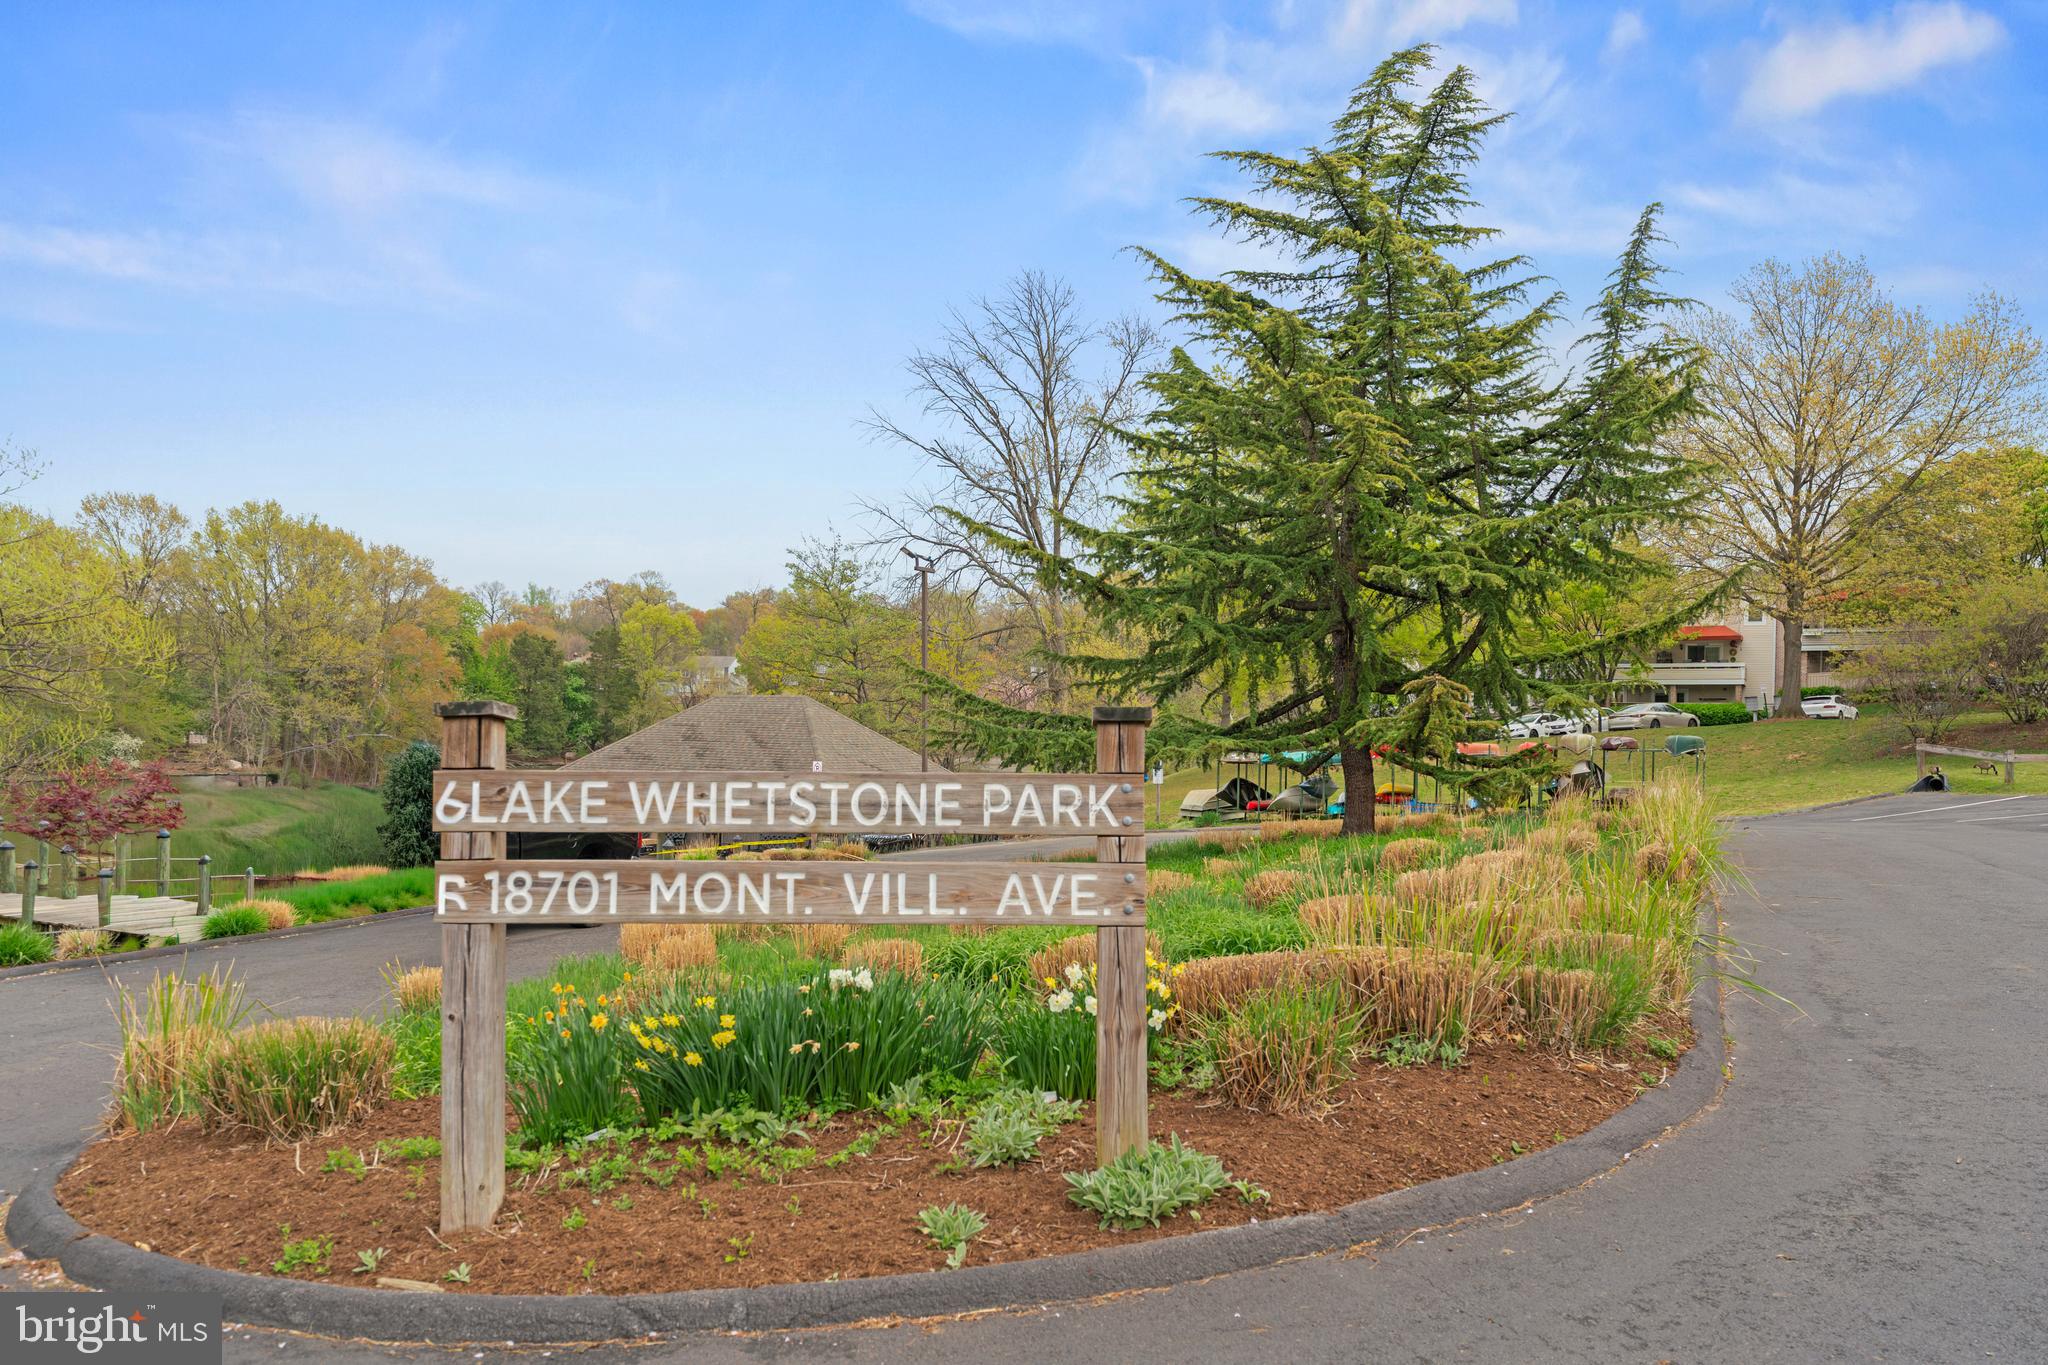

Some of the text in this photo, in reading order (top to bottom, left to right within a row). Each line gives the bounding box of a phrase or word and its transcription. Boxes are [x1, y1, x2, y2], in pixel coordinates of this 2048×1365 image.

[628, 781, 962, 827] WHETSTONE
[983, 784, 1120, 827] PARK
[484, 870, 618, 915] 18701
[650, 872, 813, 915] MONT.
[843, 873, 967, 915] VILL.
[996, 873, 1112, 916] AVE.
